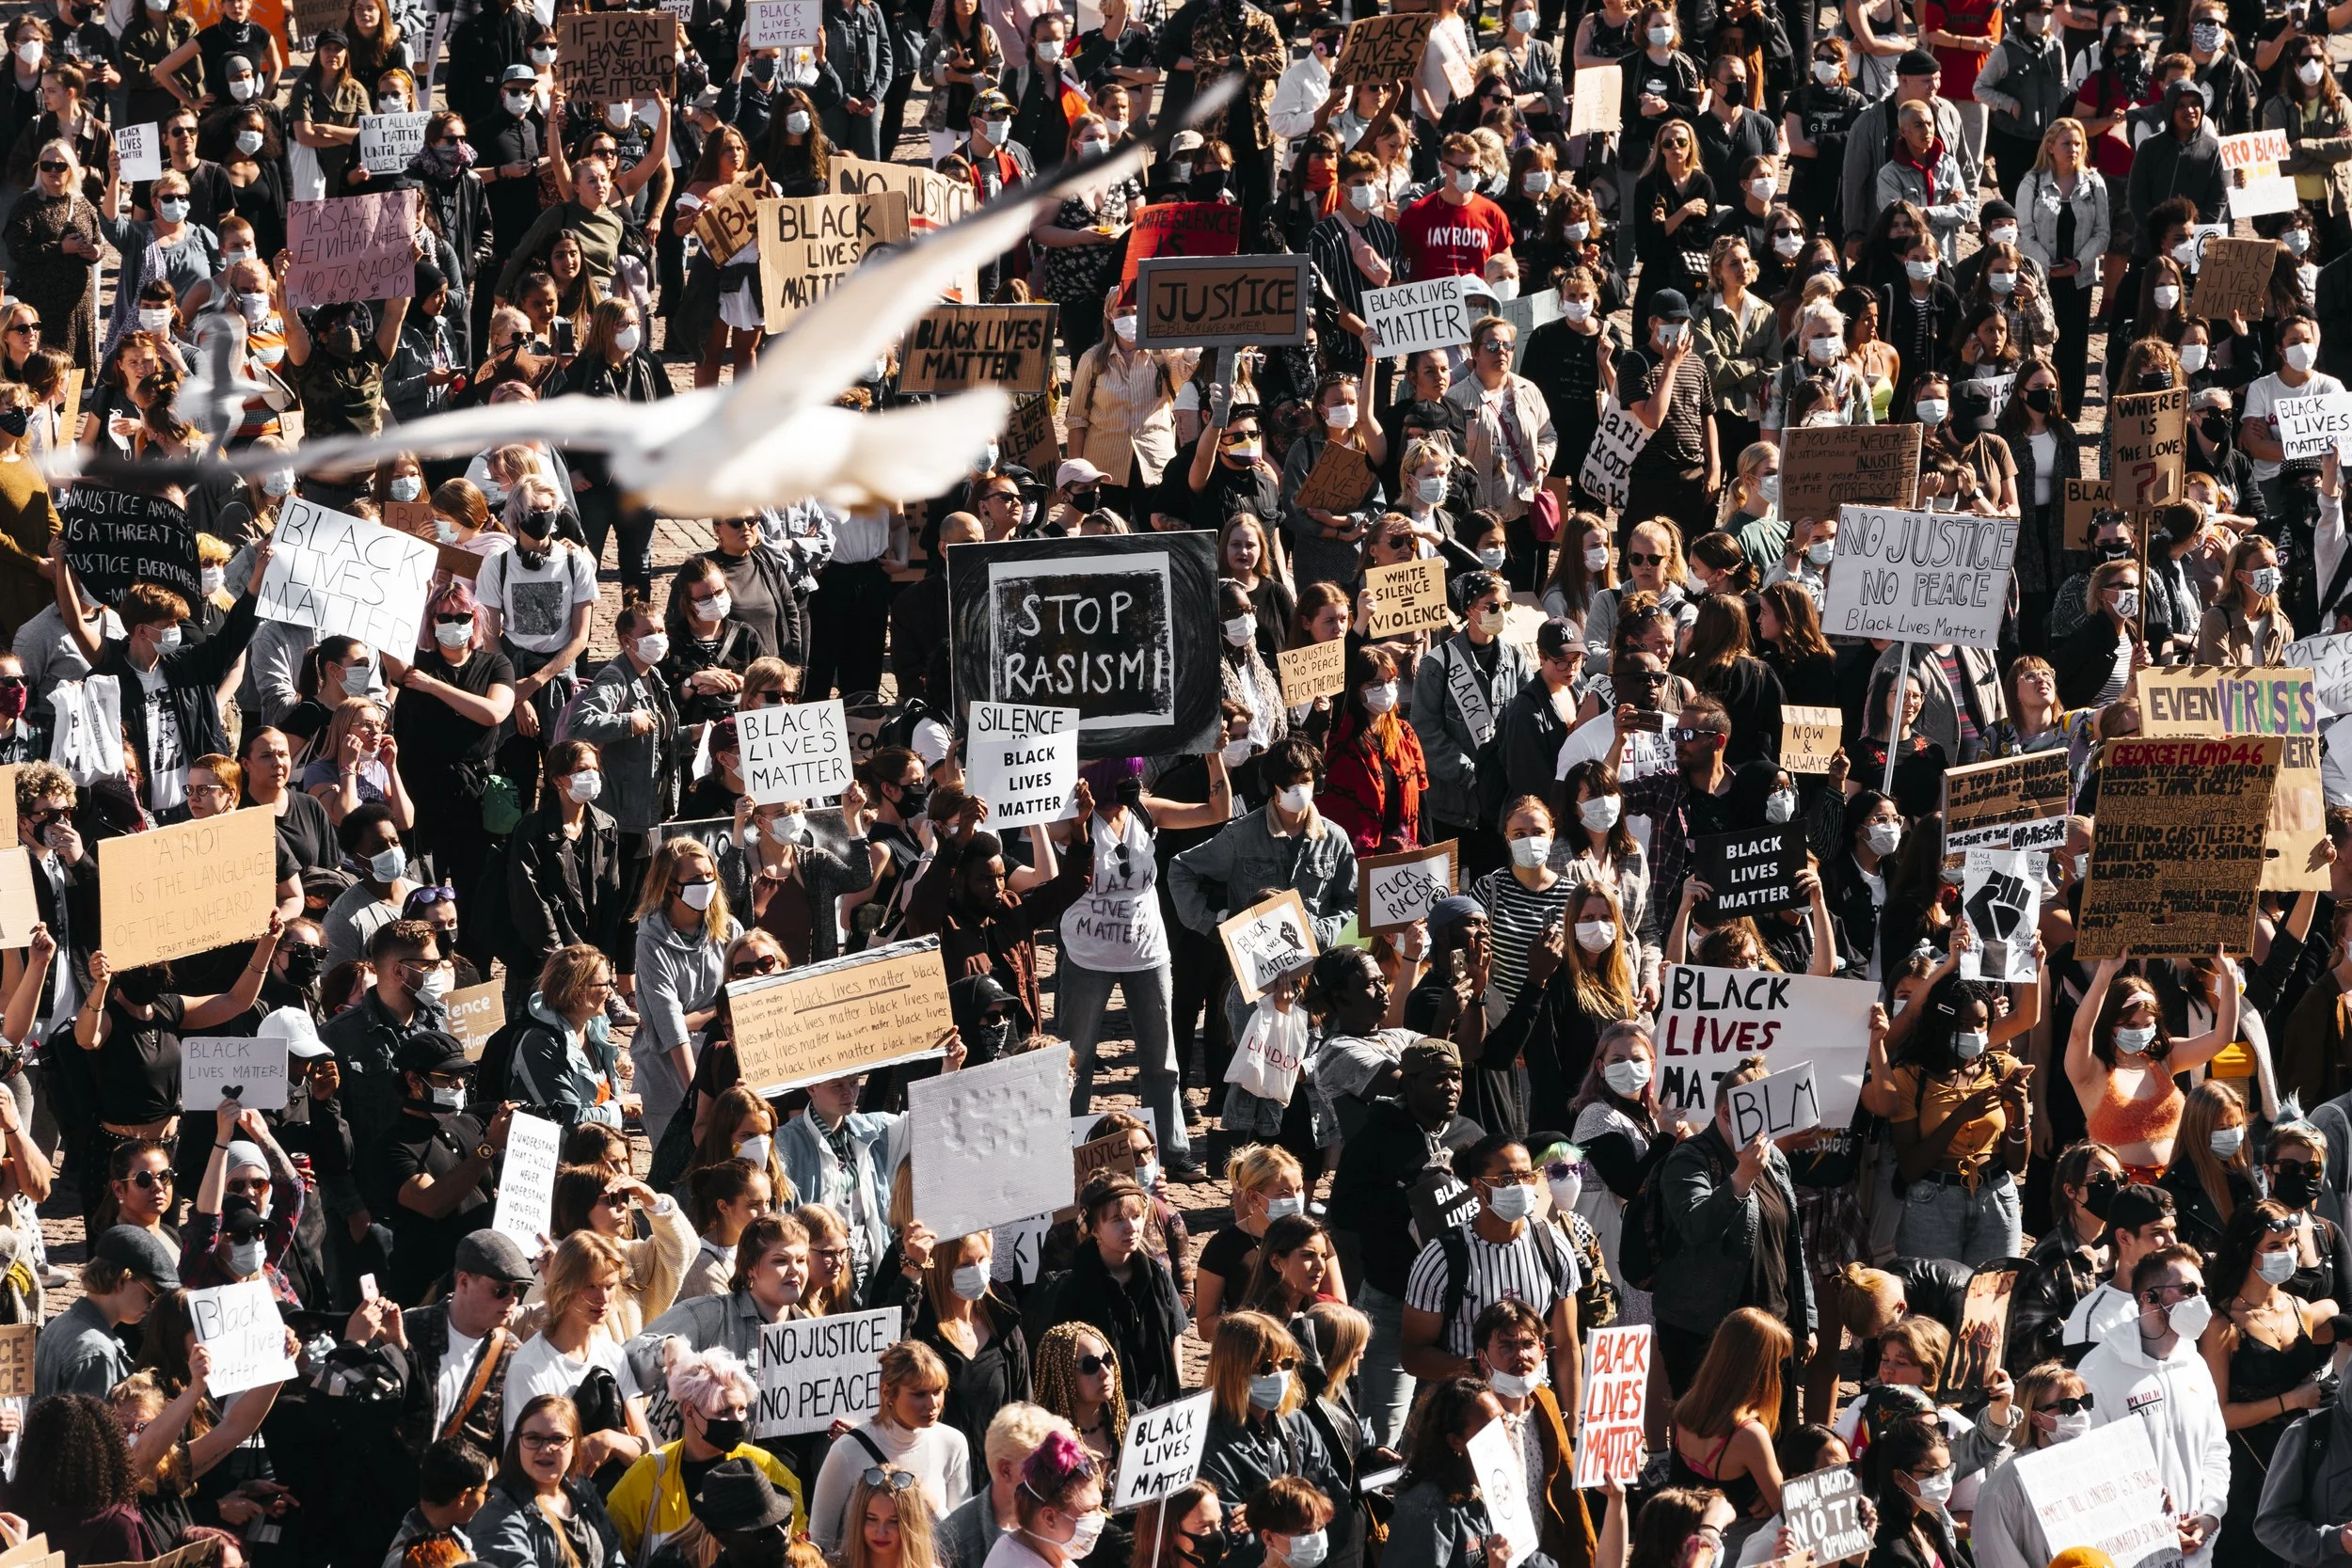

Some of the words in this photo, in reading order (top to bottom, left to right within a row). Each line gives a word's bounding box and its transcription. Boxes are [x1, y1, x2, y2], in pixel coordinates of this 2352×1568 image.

[759, 4, 803, 17] BLACK
[762, 16, 800, 28] LIVES
[571, 22, 598, 45] IF
[605, 24, 613, 40] I
[615, 20, 659, 39] CAN
[758, 29, 806, 41] MATTER
[1351, 17, 1430, 44] BLACK
[587, 41, 636, 60] HAVE
[639, 41, 663, 56] IT
[1350, 40, 1413, 62] LIVES
[561, 60, 611, 79] THEY
[612, 55, 675, 77] SHOULD
[1356, 61, 1415, 82] MATTER
[564, 78, 609, 96] HAVE
[119, 127, 140, 137] BLACK
[363, 118, 384, 130] NOT
[389, 118, 403, 128] ALL
[406, 117, 428, 126] LIVES
[383, 130, 421, 142] MATTER
[119, 138, 142, 150] LIVES
[120, 150, 143, 159] MATTER
[2221, 140, 2249, 166] PRO
[367, 158, 396, 170] LIVES
[300, 200, 413, 235] TASA-ARVO
[778, 204, 877, 242] BLACK
[1136, 211, 1169, 232] WHITE
[1172, 206, 1239, 235] SILENCE
[298, 238, 321, 264] EI
[807, 242, 861, 269] LIVES
[2214, 244, 2268, 270] BLACK
[301, 269, 325, 294] NO
[327, 264, 351, 290] TO
[2206, 270, 2259, 294] LIVES
[1156, 274, 1297, 322] JUSTICE
[1371, 288, 1418, 313] BLACK
[1420, 280, 1458, 305] LIVES
[2201, 293, 2259, 314] MATTER
[915, 319, 977, 350] BLACK
[984, 319, 1041, 350] LIVES
[1375, 304, 1469, 349] MATTER
[922, 351, 1021, 380] MATTER
[2117, 392, 2182, 419] WHERE
[2280, 399, 2325, 419] BLACK
[2140, 419, 2156, 436] IS
[2295, 413, 2349, 436] LIVES
[1805, 433, 1829, 447] YOU
[1836, 430, 1858, 444] ARE
[1860, 433, 1915, 450] NEUTRAL
[2117, 444, 2143, 463] THE
[2148, 438, 2181, 458] LOVE
[2286, 436, 2334, 454] MATTER
[1857, 451, 1917, 469] INJUSTICE
[68, 484, 139, 515] INJUSTICE
[68, 518, 84, 542] IS
[89, 523, 99, 542] A
[107, 523, 172, 544] THREAT
[1836, 513, 1886, 558] NO
[1886, 516, 2020, 571] JUSTICE
[280, 502, 425, 590] BLACK
[64, 552, 129, 574] JUSTICE
[1385, 566, 1426, 583] WHITE
[288, 546, 388, 607] LIVES
[1860, 567, 1899, 606] NO
[1912, 572, 1991, 608] PEACE
[1376, 579, 1430, 601] SILENCE
[258, 580, 414, 662] MATTER
[1017, 591, 1133, 637] STOP
[1373, 604, 1447, 631] VIOLENCE
[1846, 609, 1893, 633] Black
[1898, 616, 1930, 635] Lives
[1933, 618, 1987, 640] Matter
[1283, 653, 1298, 666] NO
[1302, 642, 1337, 662] JUSTICE
[1294, 663, 1307, 676] NO
[1311, 655, 1339, 673] PEACE
[1288, 679, 1311, 702] FUCK
[1447, 662, 1483, 720] BLACK
[2149, 686, 2217, 721] EVEN
[744, 707, 834, 740] BLACK
[978, 706, 1063, 735] SILENCE
[1788, 705, 1830, 725] BLM
[749, 731, 837, 762] LIVES
[1793, 727, 1823, 740] NOW
[1803, 739, 1813, 753] &
[1004, 746, 1055, 767] BLACK
[1785, 752, 1831, 772] ALWAYS
[2112, 743, 2180, 767] GEORGE
[2179, 743, 2231, 767] FLOYD
[2232, 743, 2265, 766] 46
[752, 758, 846, 791] MATTER
[1009, 772, 1052, 791] LIVES
[1951, 778, 1963, 794] IF
[1968, 774, 1994, 791] YOU
[1995, 765, 2021, 784] ARE
[998, 796, 1061, 817] MATTER
[181, 825, 226, 861] RIOT
[1725, 836, 1782, 860] BLACK
[1947, 836, 1963, 847] THE
[1963, 831, 1981, 846] SIDE
[1983, 831, 1993, 842] OF
[1994, 827, 2009, 840] THE
[130, 882, 144, 905] IS
[153, 874, 187, 895] THE
[192, 850, 274, 889] LANGUAGE
[1375, 867, 1422, 903] FUCK
[1731, 862, 1779, 883] LIVES
[1388, 873, 1439, 920] RACISM
[1719, 886, 1789, 910] MATTER
[113, 923, 137, 947] OF
[144, 916, 175, 937] THE
[156, 942, 184, 958] START
[186, 930, 221, 951] HEARING
[1237, 920, 1272, 955] BLACK
[1263, 936, 1280, 957] LIVES
[1258, 948, 1301, 979] MATTER
[791, 989, 826, 1009] black
[832, 980, 862, 997] lives
[869, 969, 905, 989] matter
[912, 965, 939, 978] black
[904, 991, 929, 1006] lives
[1671, 967, 1790, 1011] BLACK
[1665, 1016, 1781, 1055] LIVES
[190, 1042, 250, 1059] BLACK
[188, 1065, 225, 1080] LIVES
[232, 1064, 284, 1079] MATTER!
[1733, 1078, 1819, 1145] BLM
[517, 1132, 556, 1155] UNDERSTAND
[512, 1149, 527, 1163] THAT
[532, 1155, 551, 1170] WILL
[1077, 1141, 1129, 1174] JUSTICE
[519, 1169, 540, 1185] NEVER
[1445, 1196, 1481, 1228] LIVES
[516, 1220, 537, 1235] STAND
[194, 1294, 262, 1341] Black
[243, 1329, 282, 1359] lives
[762, 1328, 797, 1368] NO
[800, 1317, 886, 1359] JUSTICE
[1593, 1333, 1648, 1375] BLACK
[759, 1386, 789, 1423] NO
[799, 1370, 882, 1418] PEACE
[1587, 1379, 1642, 1424] LIVES
[1135, 1409, 1195, 1447] BLACK
[1143, 1433, 1190, 1466] LIVES
[1581, 1426, 1643, 1482] MATTER
[1131, 1464, 1194, 1498] MATTER
[1819, 1469, 1856, 1497] RIGHTS
[1821, 1524, 1871, 1561] OPINION
